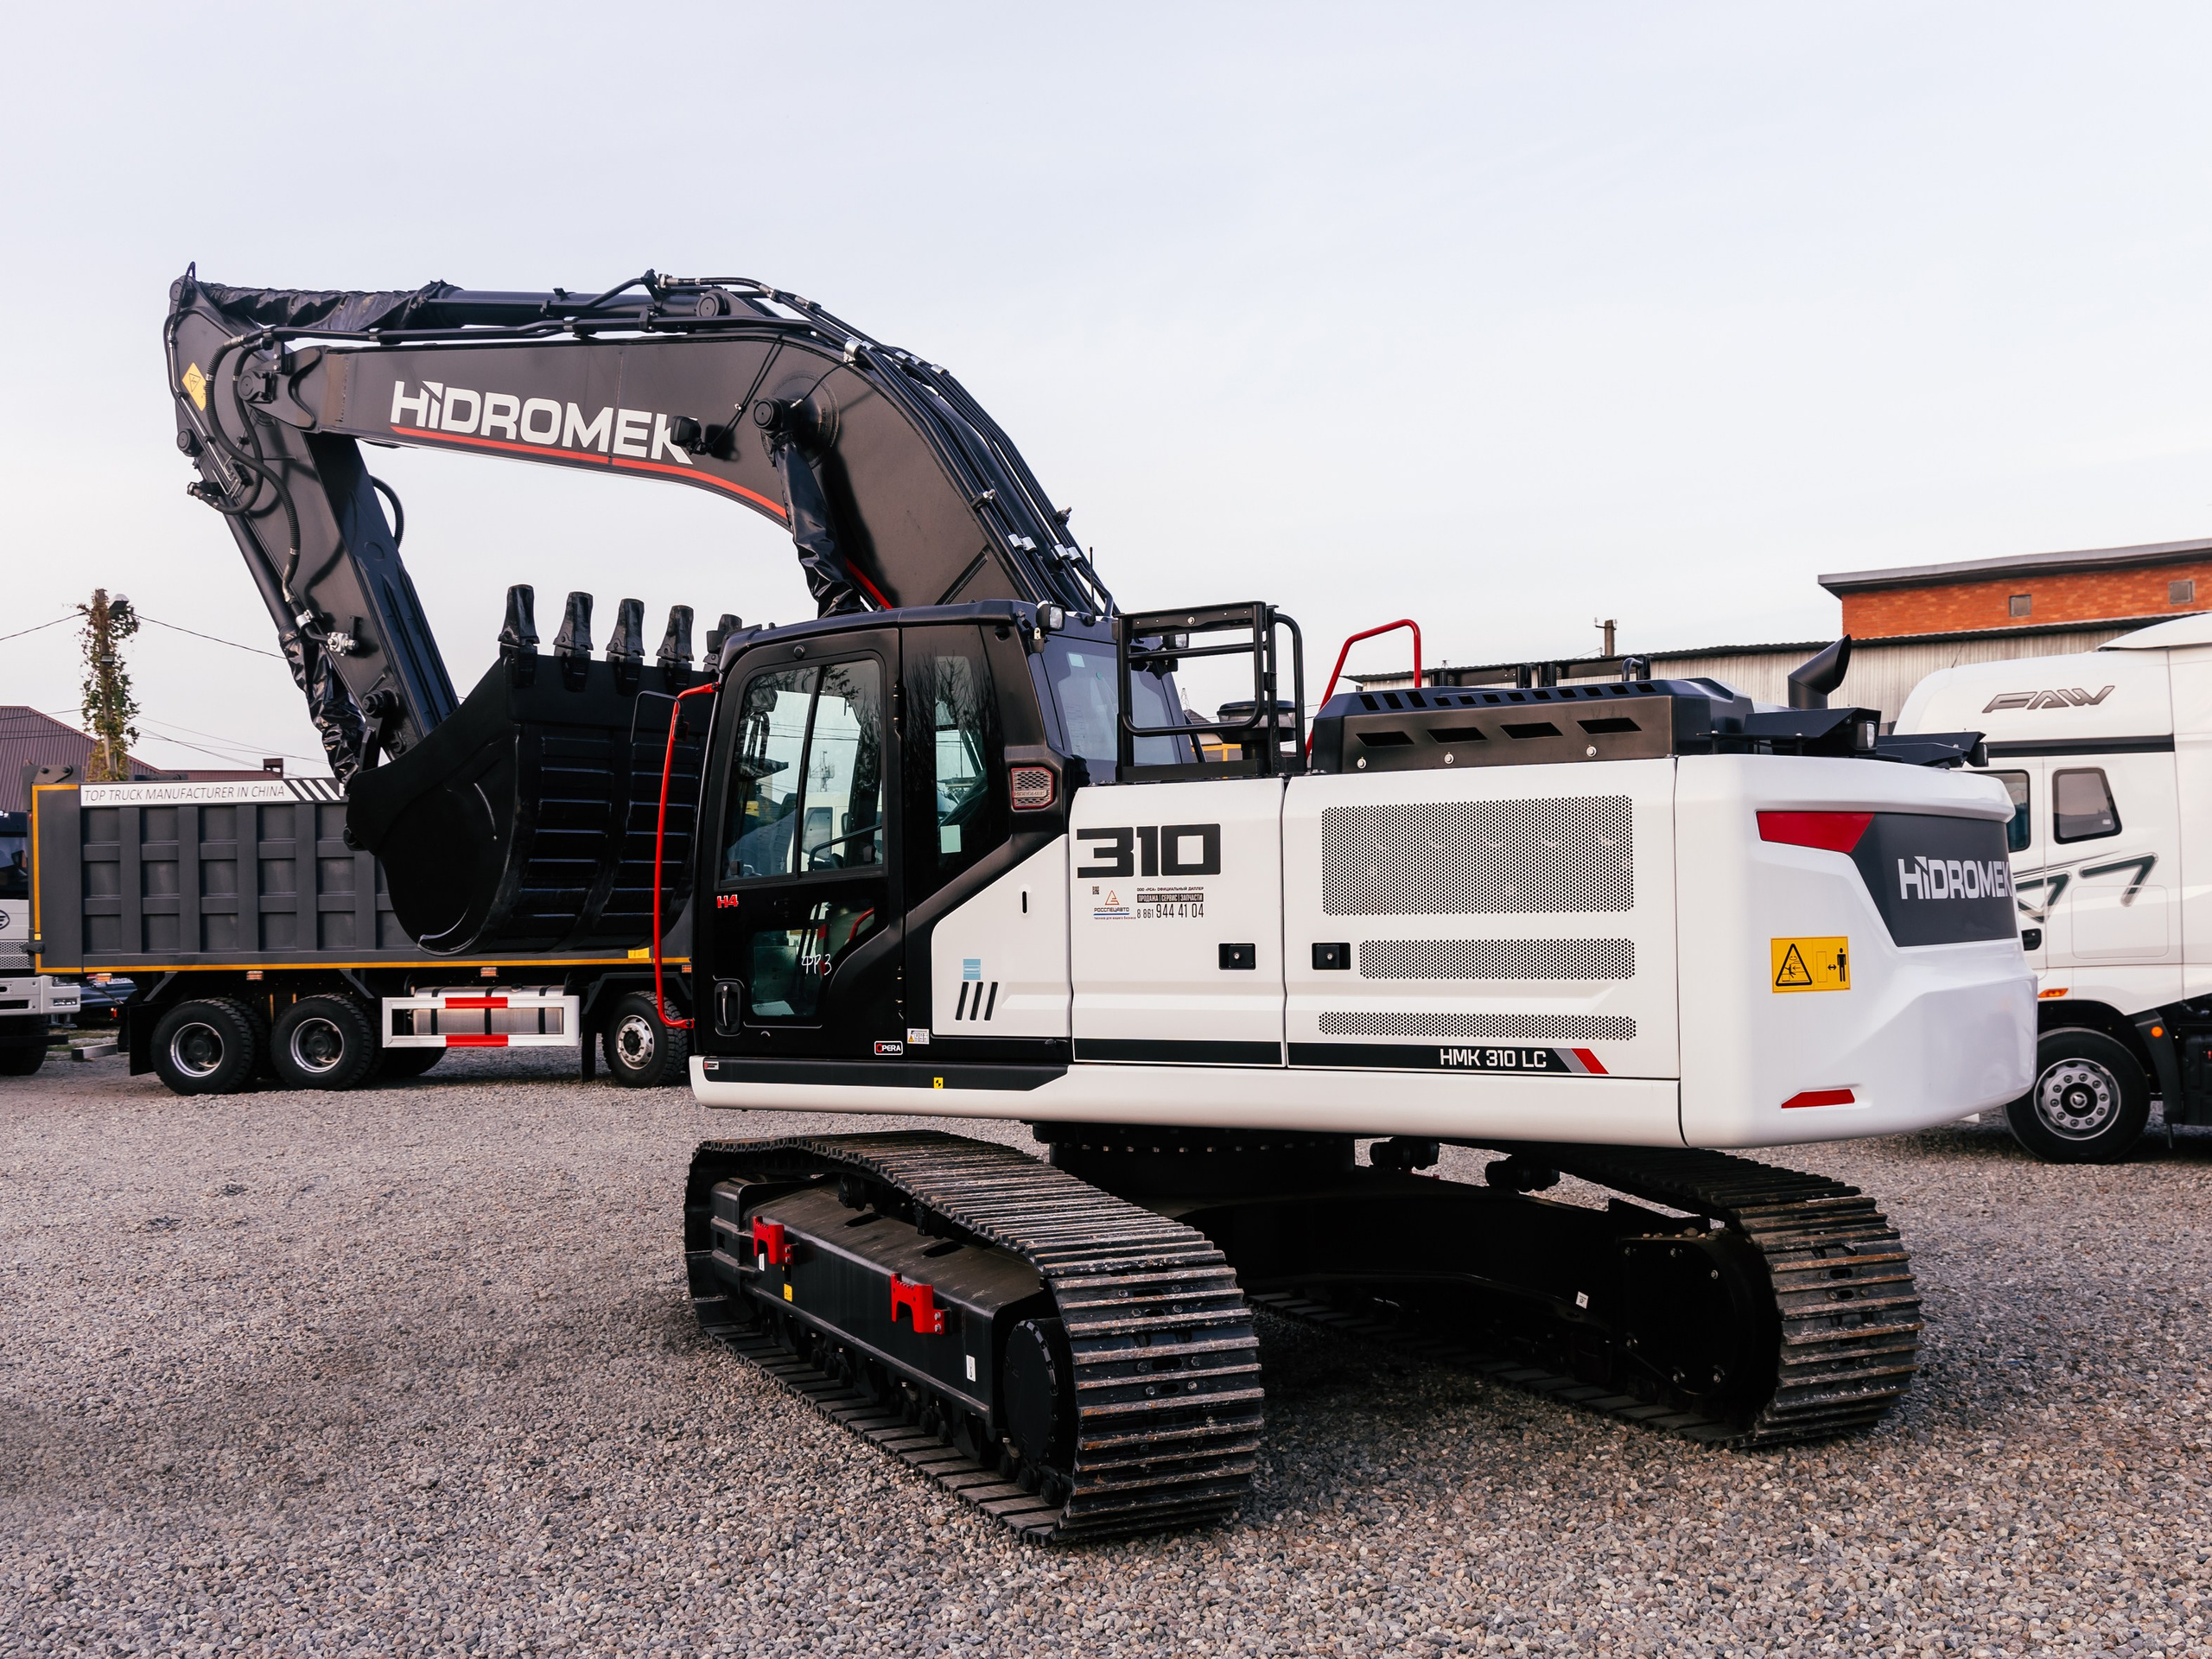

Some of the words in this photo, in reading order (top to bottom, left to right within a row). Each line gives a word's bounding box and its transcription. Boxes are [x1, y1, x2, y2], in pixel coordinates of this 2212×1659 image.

[1982, 685, 2115, 713] FAW
[85, 789, 105, 802] TOP
[109, 788, 143, 801] TRUCK
[145, 786, 235, 800] MANUFACTURER
[237, 786, 249, 798] IN
[251, 785, 285, 798] CHINA
[1077, 823, 1221, 878] 310
[717, 894, 739, 908] H4
[1136, 909, 1141, 918] 8
[1143, 909, 1154, 918] 861
[1156, 904, 1174, 918] 944
[1178, 904, 1187, 918] 41
[1192, 903, 1204, 918] 04
[876, 1043, 901, 1052] OPERA
[1440, 1048, 1481, 1066] HMK
[1486, 1050, 1516, 1067] 310
[1522, 1050, 1547, 1068] LC
